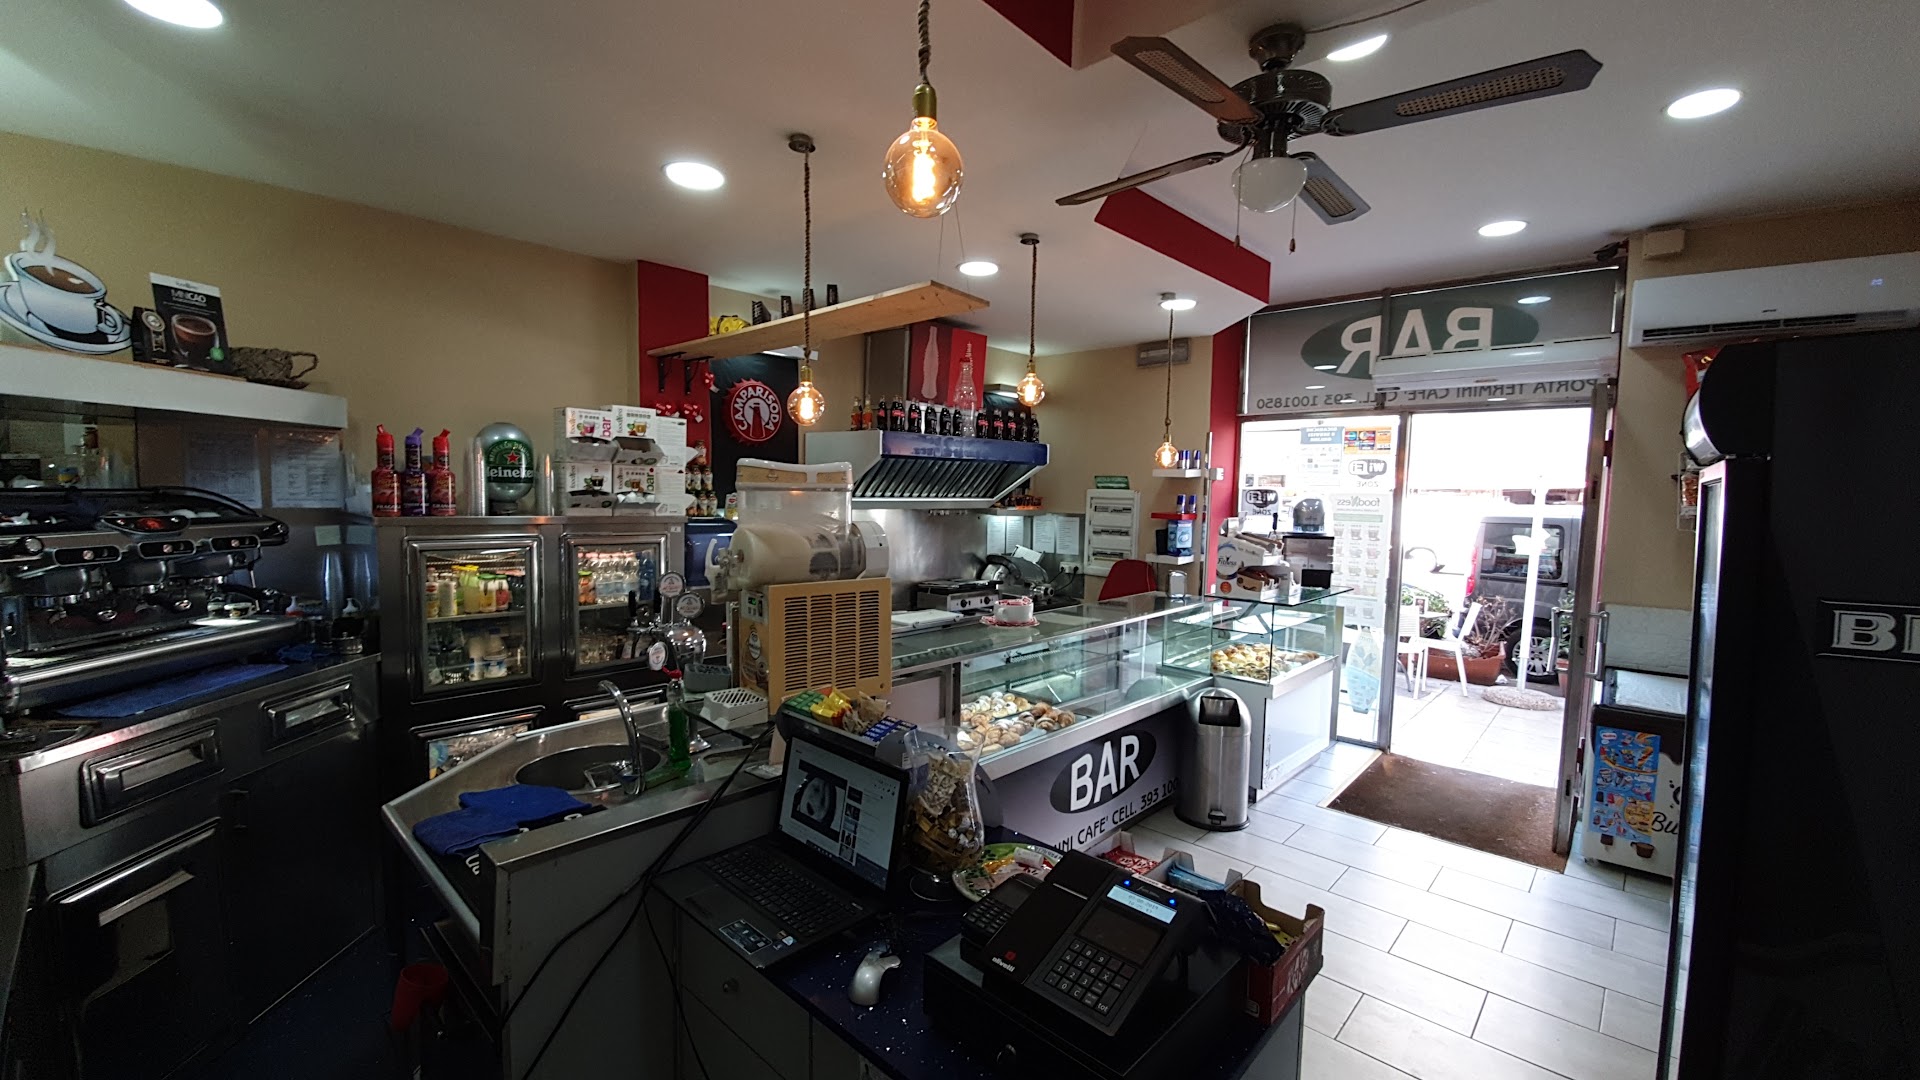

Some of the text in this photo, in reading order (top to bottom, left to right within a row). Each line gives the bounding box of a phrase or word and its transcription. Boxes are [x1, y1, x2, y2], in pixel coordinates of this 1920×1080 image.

[600, 416, 612, 438] bar
[487, 466, 534, 479] eineke
[1070, 734, 1140, 812] BAR
[1077, 816, 1109, 846] CAFE'
[1112, 802, 1137, 825] CELL.
[1140, 787, 1159, 811] 393
[991, 955, 1016, 973] olivetti
[1097, 1002, 1109, 1013] tot
